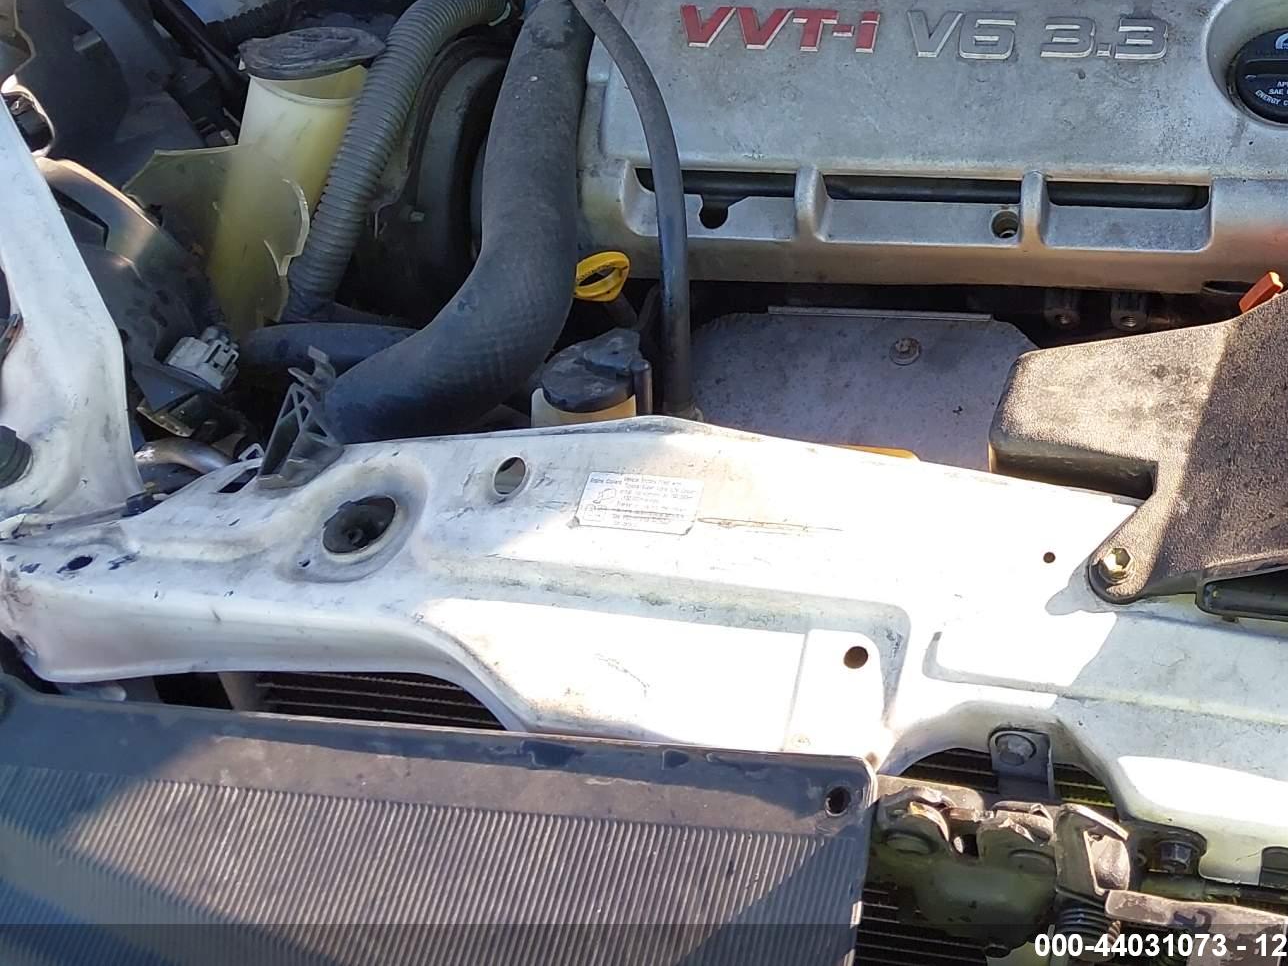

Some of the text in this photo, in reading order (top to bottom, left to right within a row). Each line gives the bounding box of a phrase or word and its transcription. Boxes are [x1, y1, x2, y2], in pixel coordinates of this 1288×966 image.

[680, 4, 1169, 61] VVT-i V6 3.3
[1255, 89, 1281, 105] ENERGY
